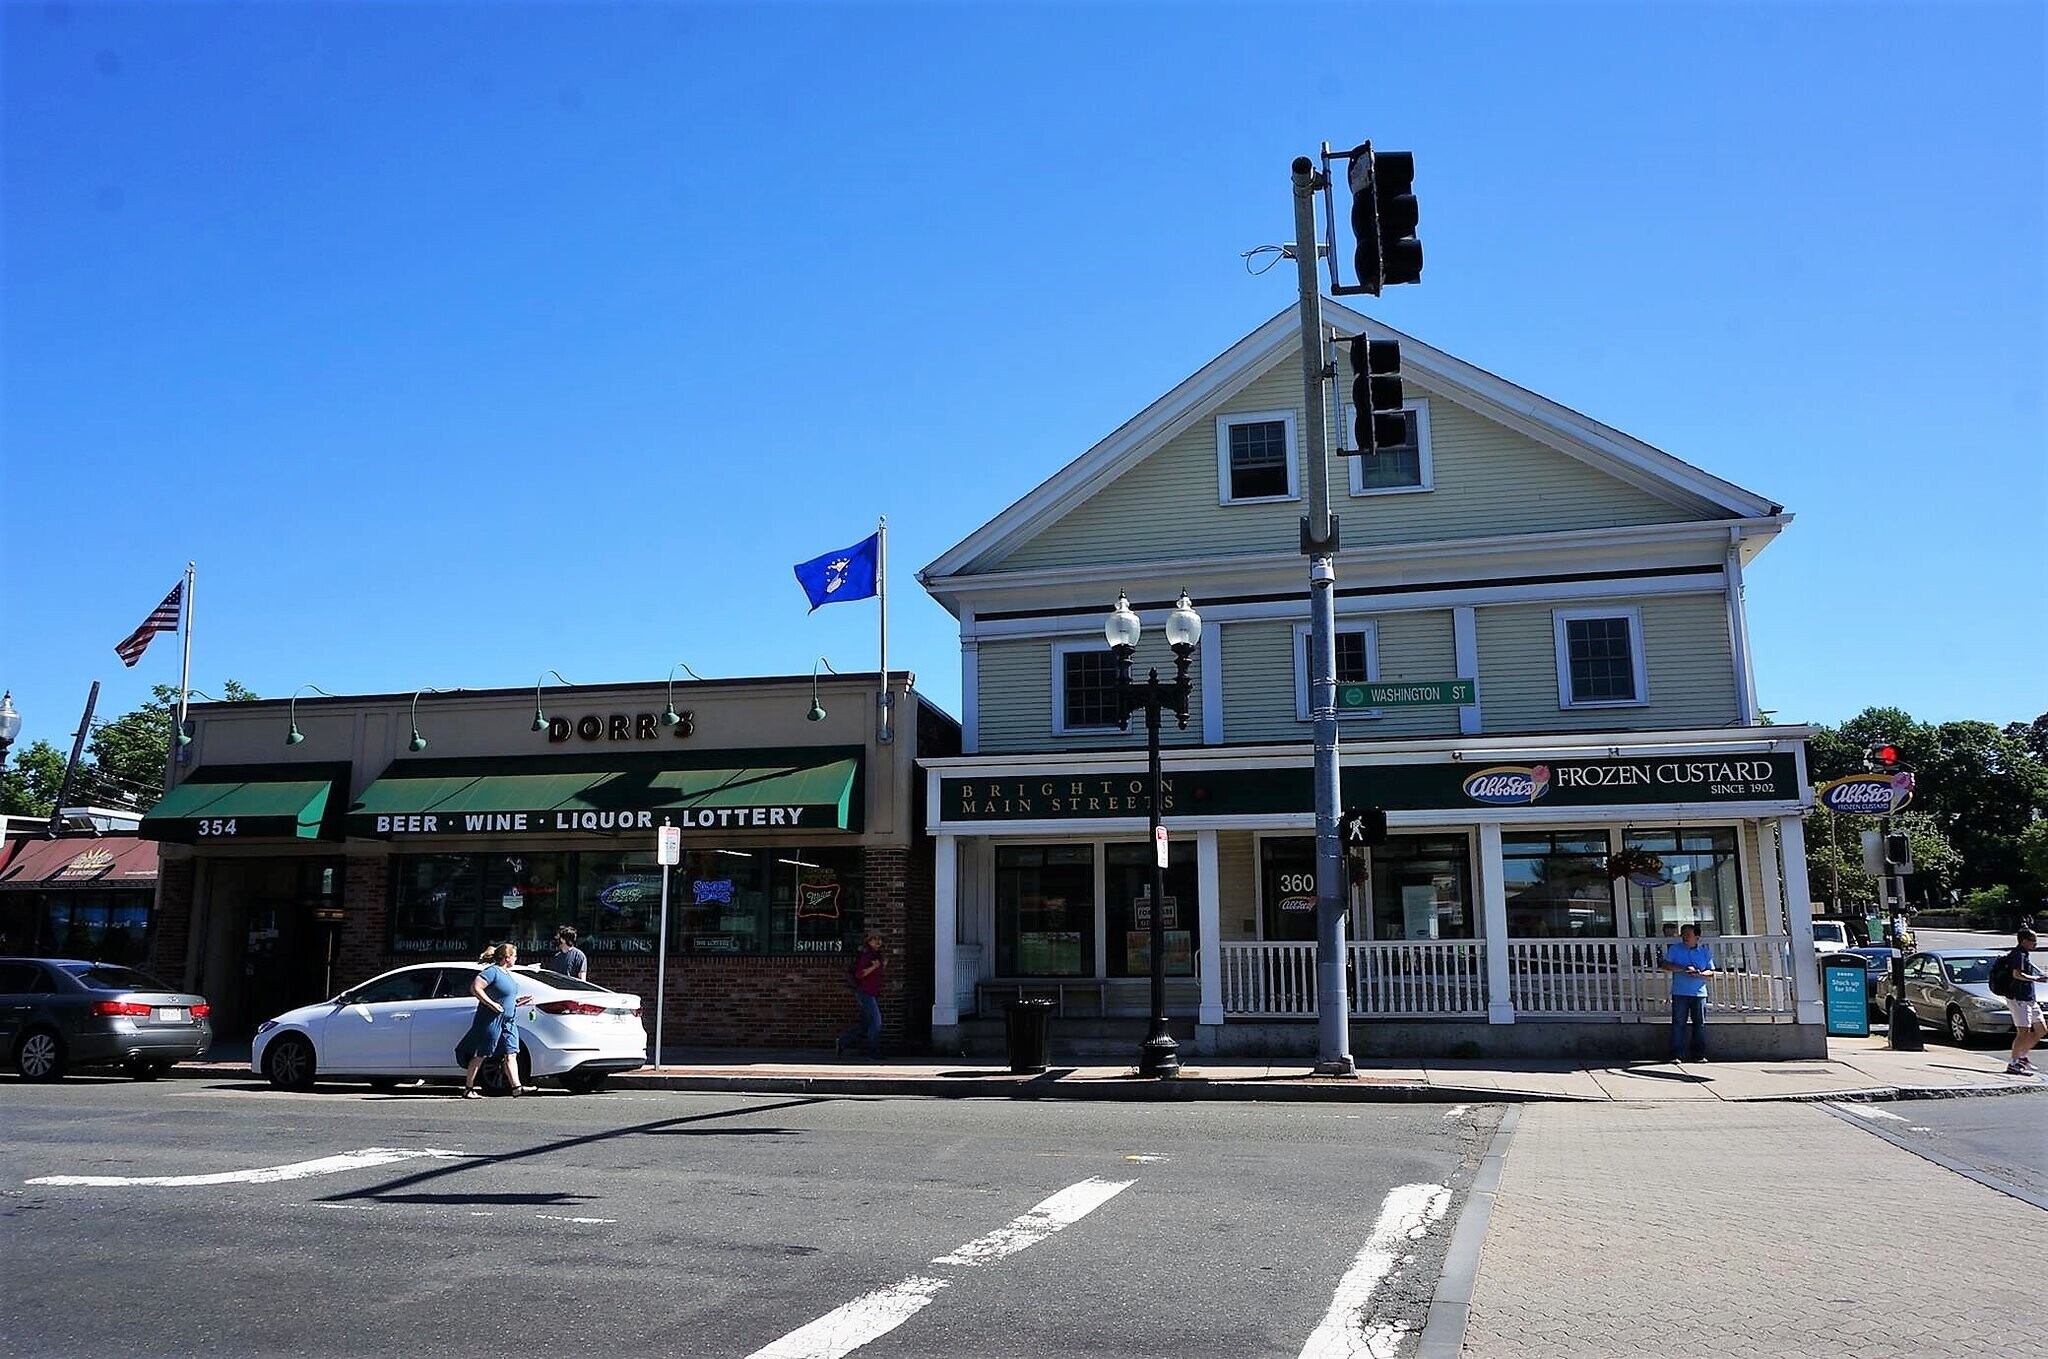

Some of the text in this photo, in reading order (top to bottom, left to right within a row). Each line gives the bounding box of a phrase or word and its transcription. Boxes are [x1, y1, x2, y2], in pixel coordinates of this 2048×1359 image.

[1371, 685, 1466, 702] WASHINGTON ST
[1557, 761, 1774, 787] FROZEN CUSTARD
[963, 780, 1173, 798] BRIGHTON
[1711, 783, 1775, 795] SINCE 1902
[963, 798, 1032, 813] MAIN
[198, 819, 237, 836] 354
[377, 808, 804, 832] BEER WINE LIQUOR LOTTERY
[1280, 874, 1314, 892] 360
[435, 938, 468, 951] CARDS
[593, 938, 652, 951] FINE WINES
[797, 939, 842, 951] SPIRITS
